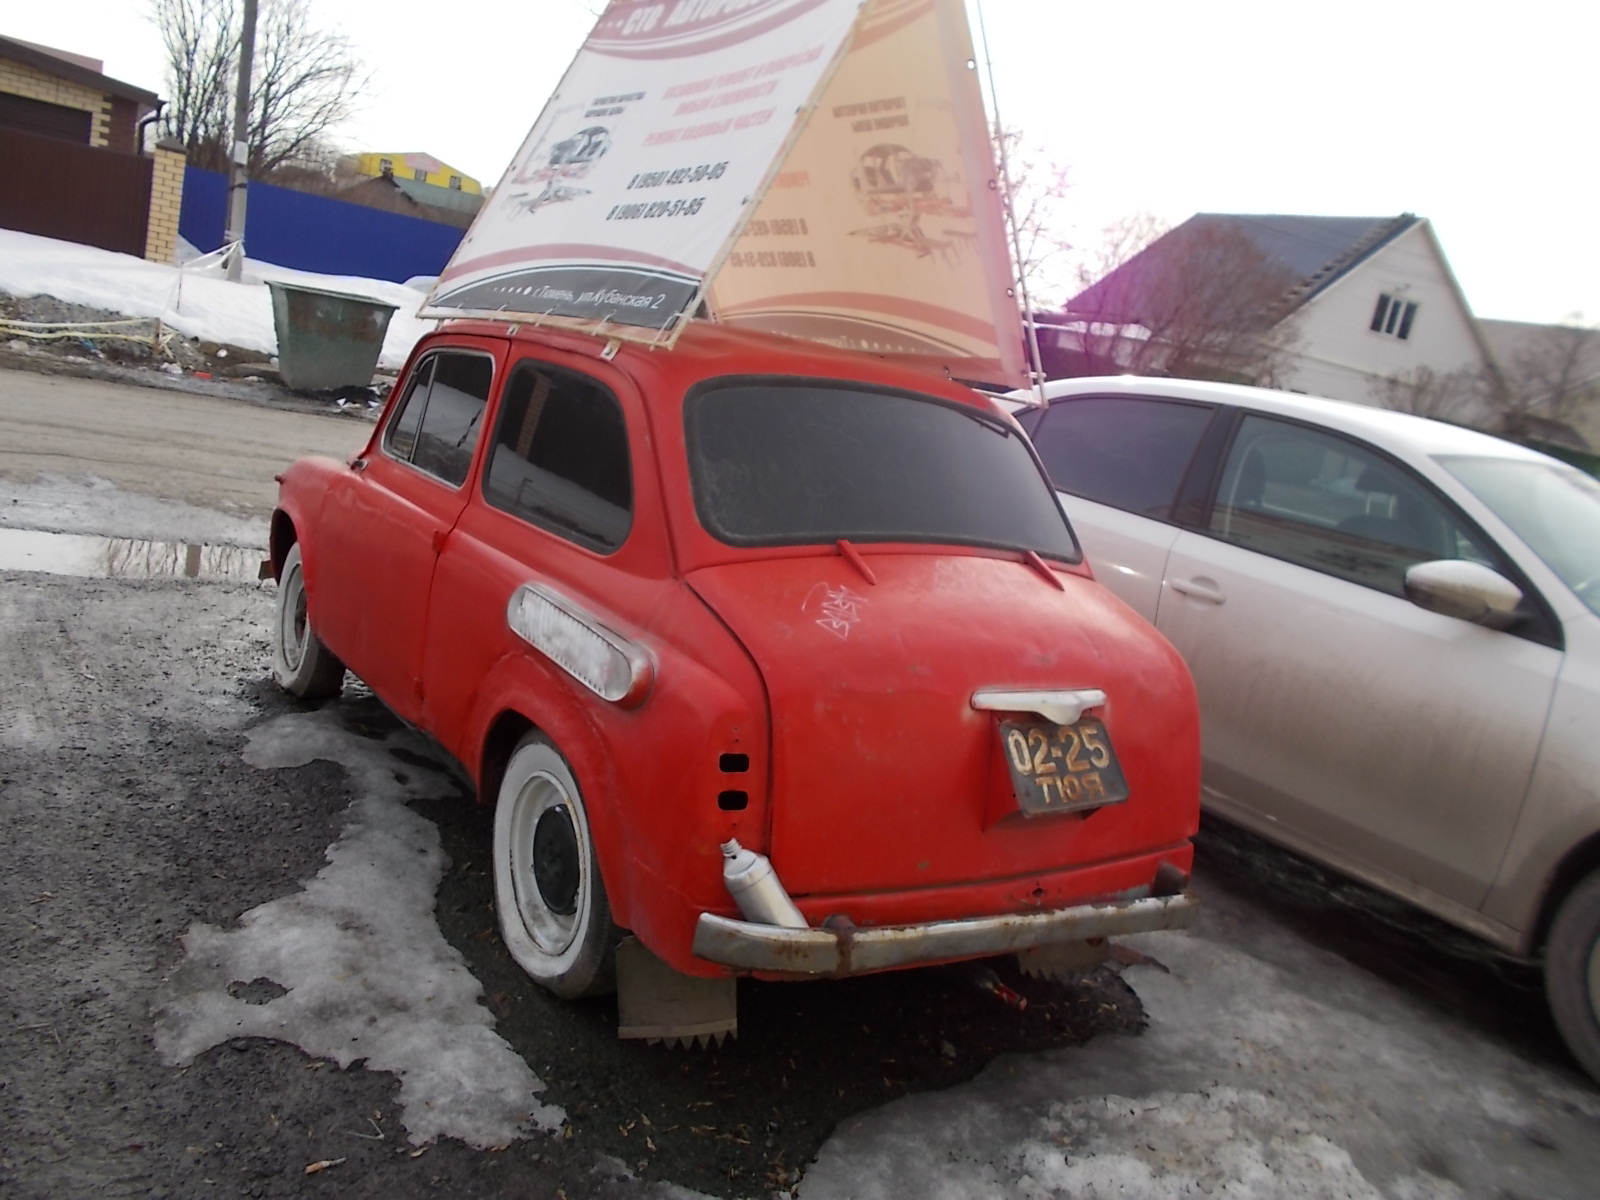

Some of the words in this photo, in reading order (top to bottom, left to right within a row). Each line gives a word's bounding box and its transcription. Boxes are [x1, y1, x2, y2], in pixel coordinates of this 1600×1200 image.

[627, 172, 640, 190] 8
[606, 204, 619, 221] 8
[650, 293, 666, 309] 2
[1008, 725, 1110, 776] 02-25
